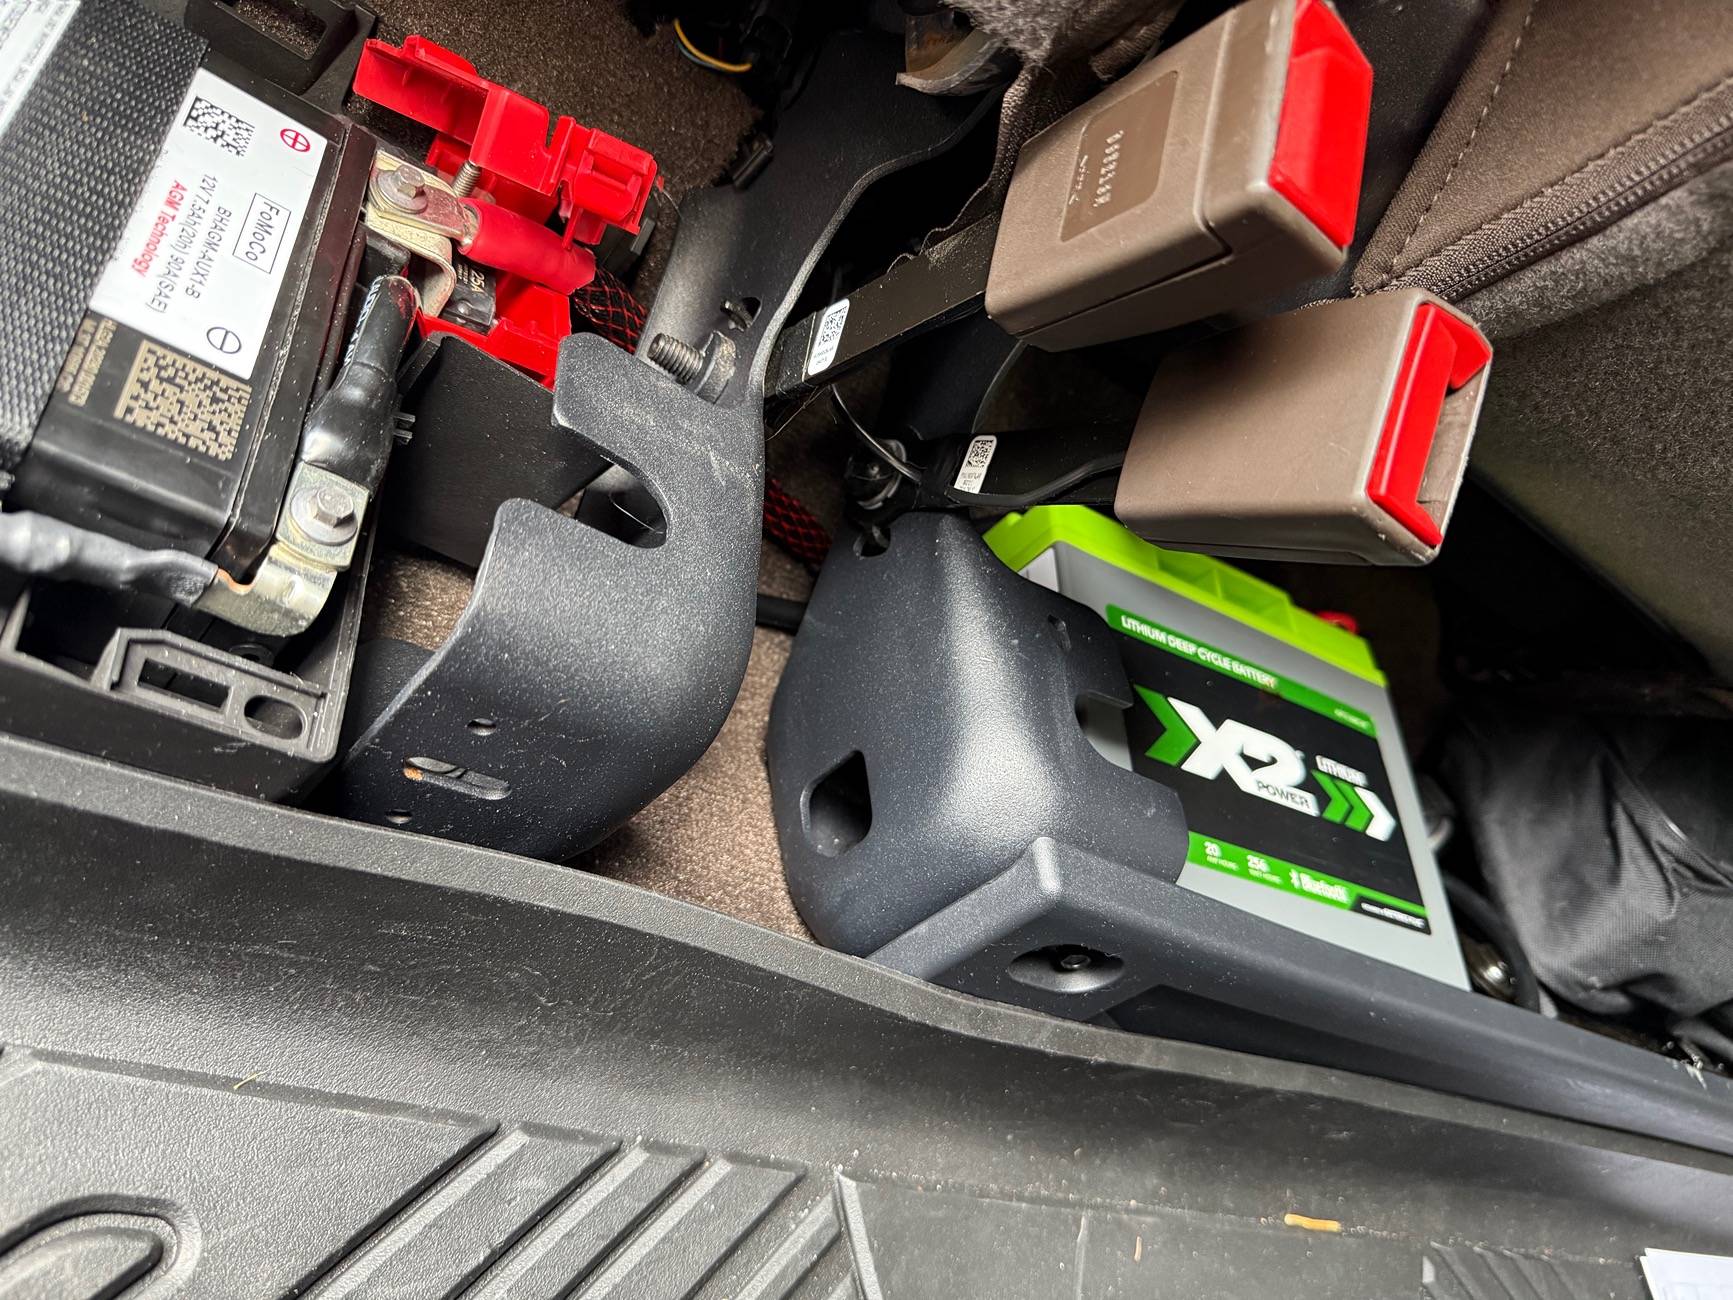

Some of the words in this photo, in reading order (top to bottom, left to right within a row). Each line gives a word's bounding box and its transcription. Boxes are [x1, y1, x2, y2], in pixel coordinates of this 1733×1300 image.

[163, 179, 188, 212] AGM
[199, 174, 219, 198] 12V
[131, 210, 177, 279] Technology
[185, 206, 232, 300] BHAGM-AUX1-B
[245, 201, 280, 262] FoMoCo
[470, 268, 488, 297] 25A
[1121, 615, 1168, 645] LITHIUM
[1167, 635, 1197, 656] DEEP
[1197, 646, 1232, 671] CYCLE
[1231, 660, 1278, 689] BATTERY
[1167, 696, 1320, 817] X2
[1256, 779, 1312, 809] POWER
